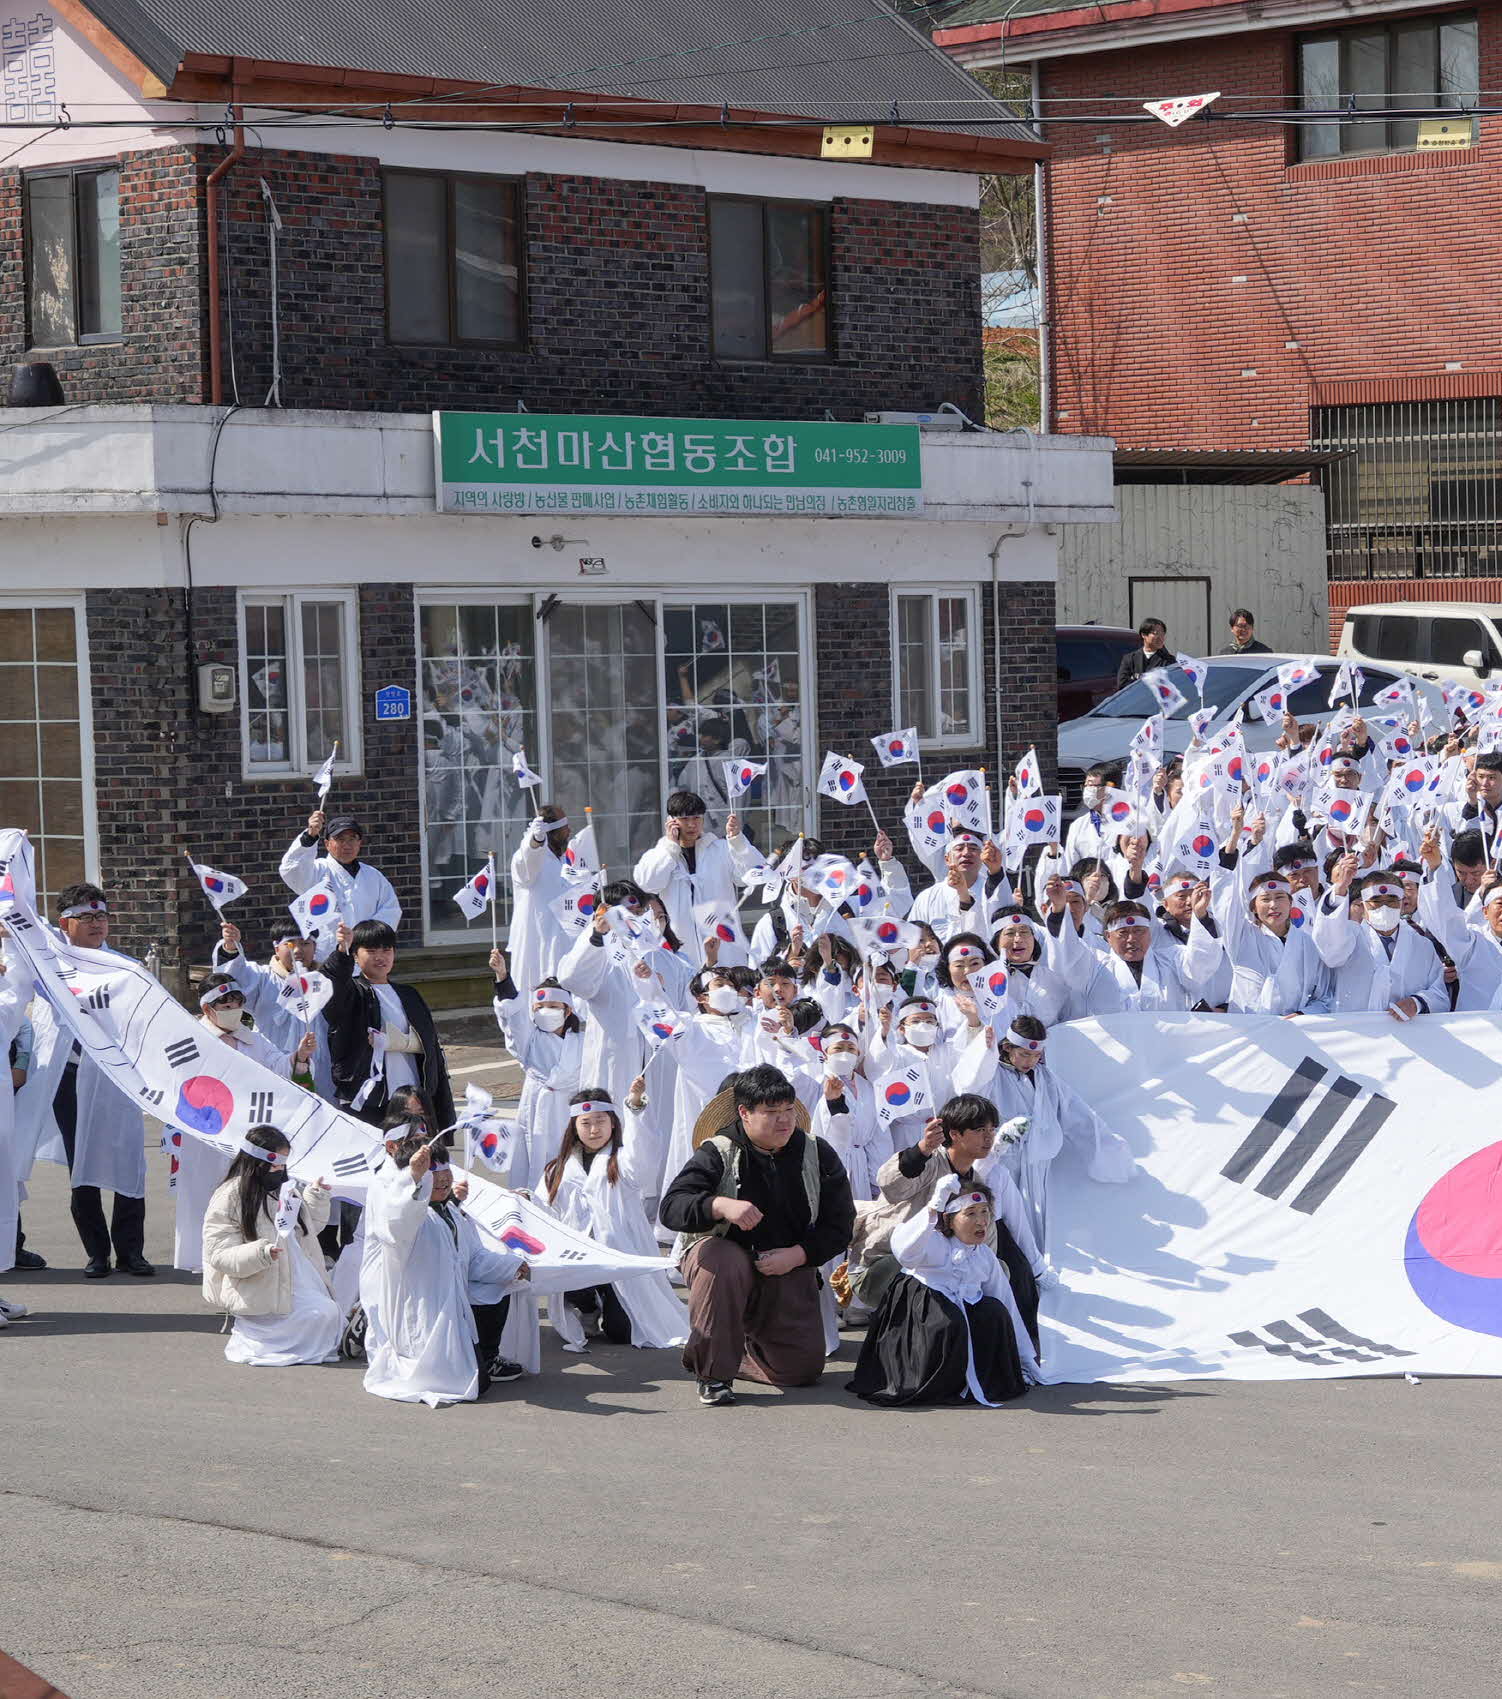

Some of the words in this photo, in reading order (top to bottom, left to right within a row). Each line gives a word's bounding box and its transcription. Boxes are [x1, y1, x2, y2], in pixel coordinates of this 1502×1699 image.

[468, 428, 797, 473] 서천마산협동조합
[815, 448, 906, 464] 041-952-3009
[383, 703, 404, 715] 280
